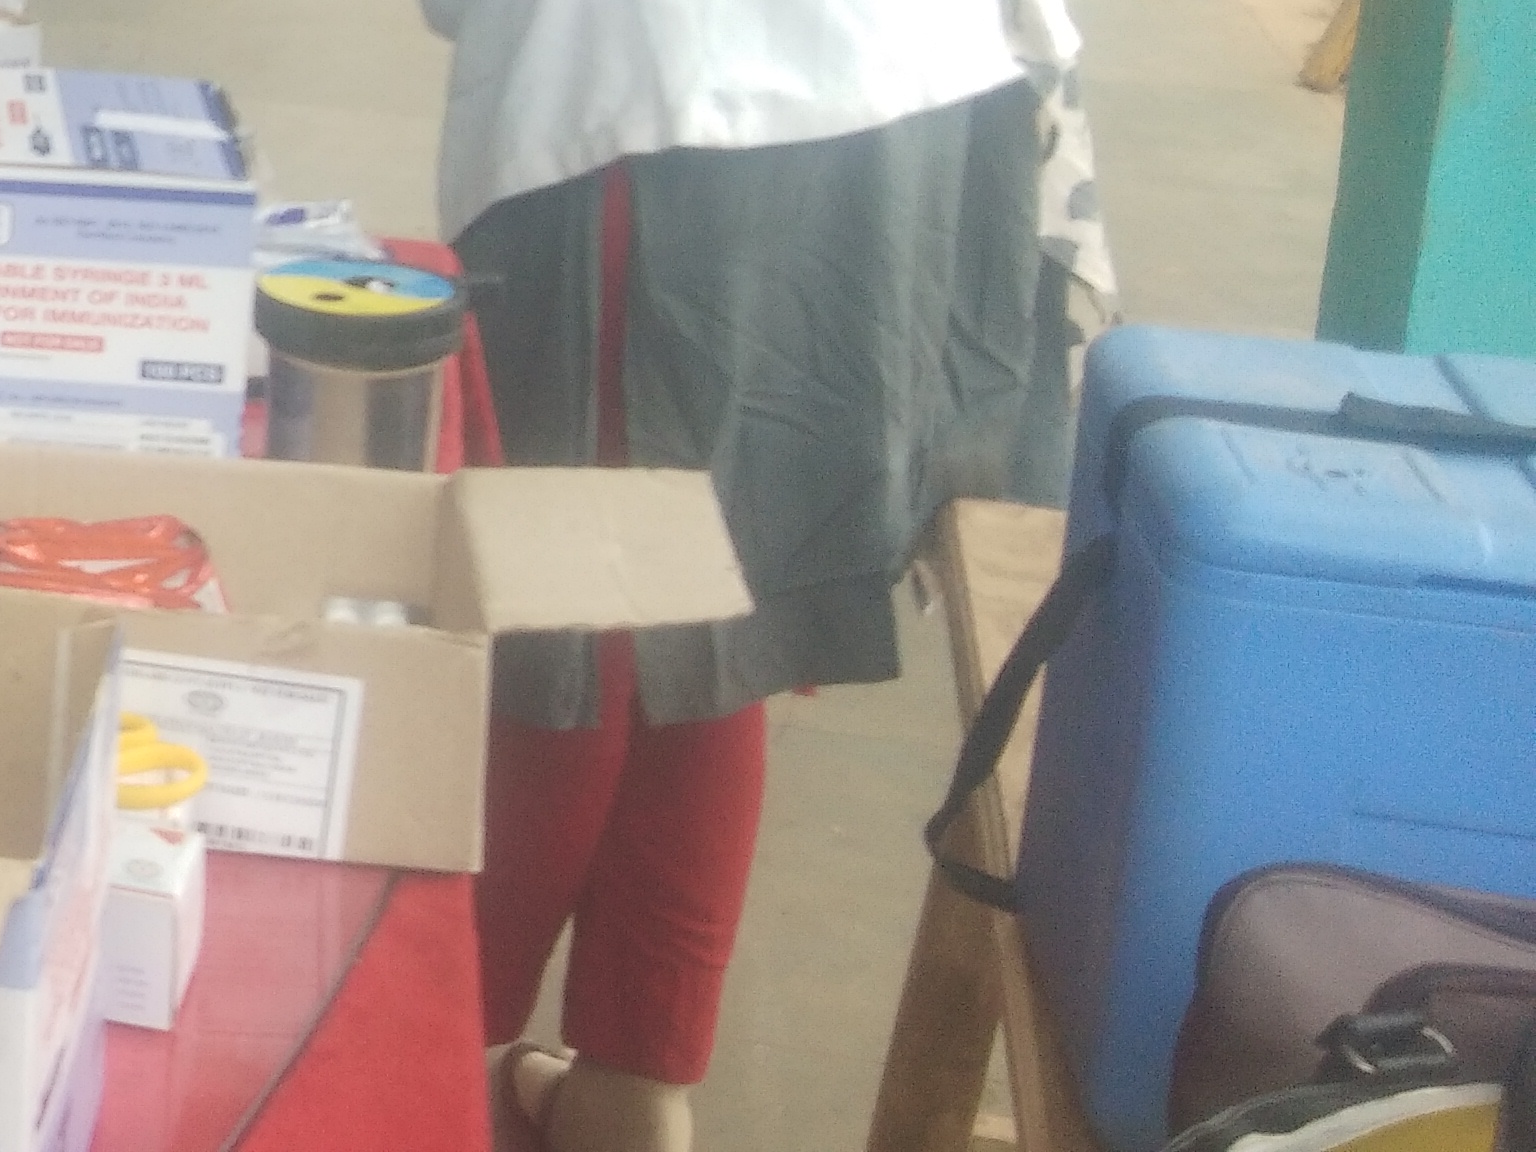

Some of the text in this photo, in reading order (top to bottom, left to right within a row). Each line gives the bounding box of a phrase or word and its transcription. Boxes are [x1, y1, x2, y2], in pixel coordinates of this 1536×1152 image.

[52, 265, 151, 287] SYRINGE
[87, 289, 118, 305] OF
[124, 292, 187, 309] INDIA
[42, 309, 210, 333] IMMUNIZATION
